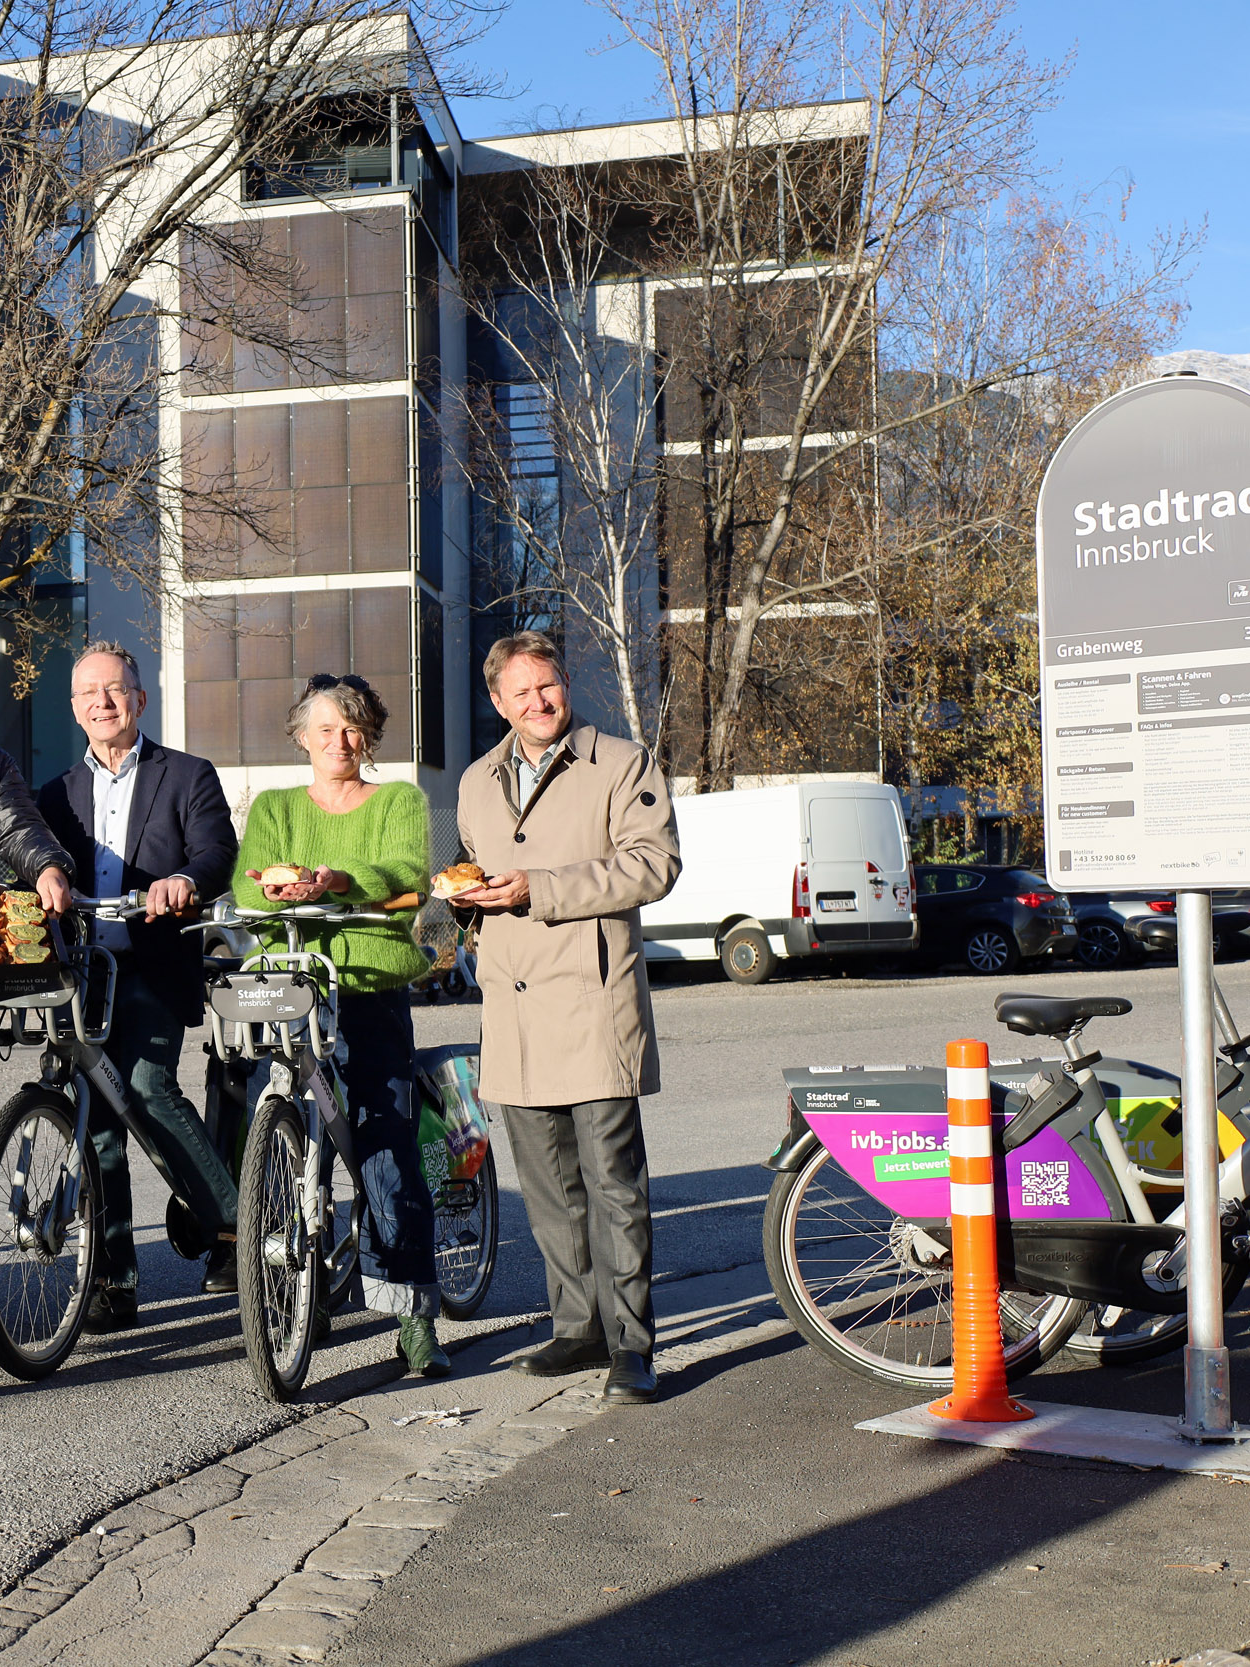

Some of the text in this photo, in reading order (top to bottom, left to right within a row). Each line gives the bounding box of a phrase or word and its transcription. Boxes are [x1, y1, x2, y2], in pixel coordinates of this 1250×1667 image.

[1075, 527, 1215, 569] Innsbruck
[1056, 638, 1144, 658] Grabenweg
[1083, 678, 1100, 686] Rental
[1141, 671, 1212, 684] Scannen & Fahren
[1091, 726, 1115, 735] Stopover
[1059, 767, 1084, 775] Rückgabe
[4, 984, 35, 992] Innsbruck
[237, 988, 284, 999] Stadtrad
[238, 999, 272, 1007] Innsbruck
[995, 1080, 1026, 1090] tadtra
[806, 1092, 849, 1101] Stadtrad
[851, 1130, 950, 1155] ivb-jobs.a
[883, 1156, 950, 1173] Jetzt bewerb
[1026, 1251, 1084, 1262] nextbike
